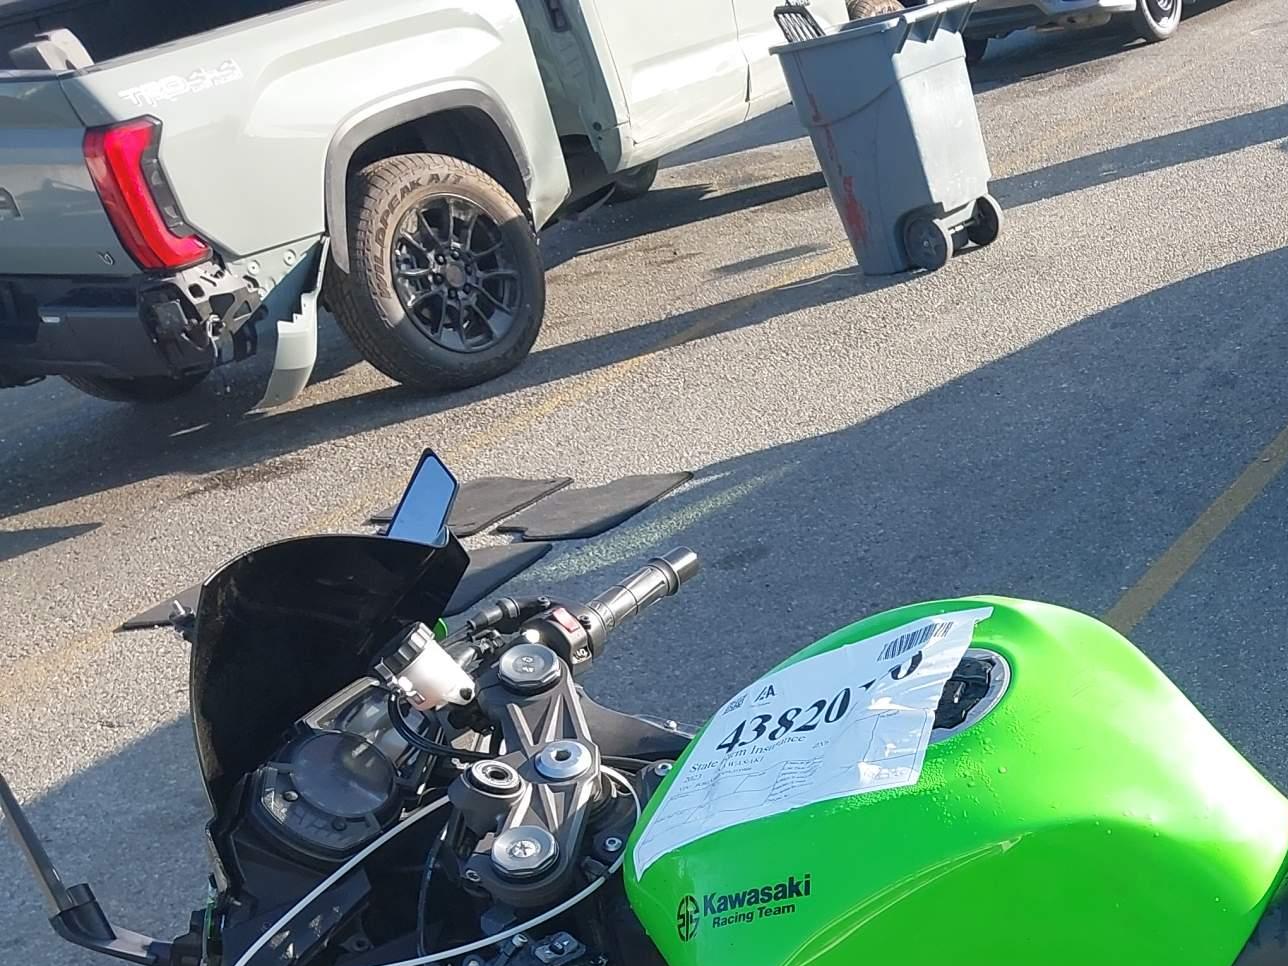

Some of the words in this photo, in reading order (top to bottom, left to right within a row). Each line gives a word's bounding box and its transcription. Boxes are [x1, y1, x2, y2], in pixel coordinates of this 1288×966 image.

[374, 177, 422, 299] WILDPEAK
[703, 874, 811, 917] Kawasaki
[712, 909, 754, 928] Racing
[757, 903, 796, 919] Team
